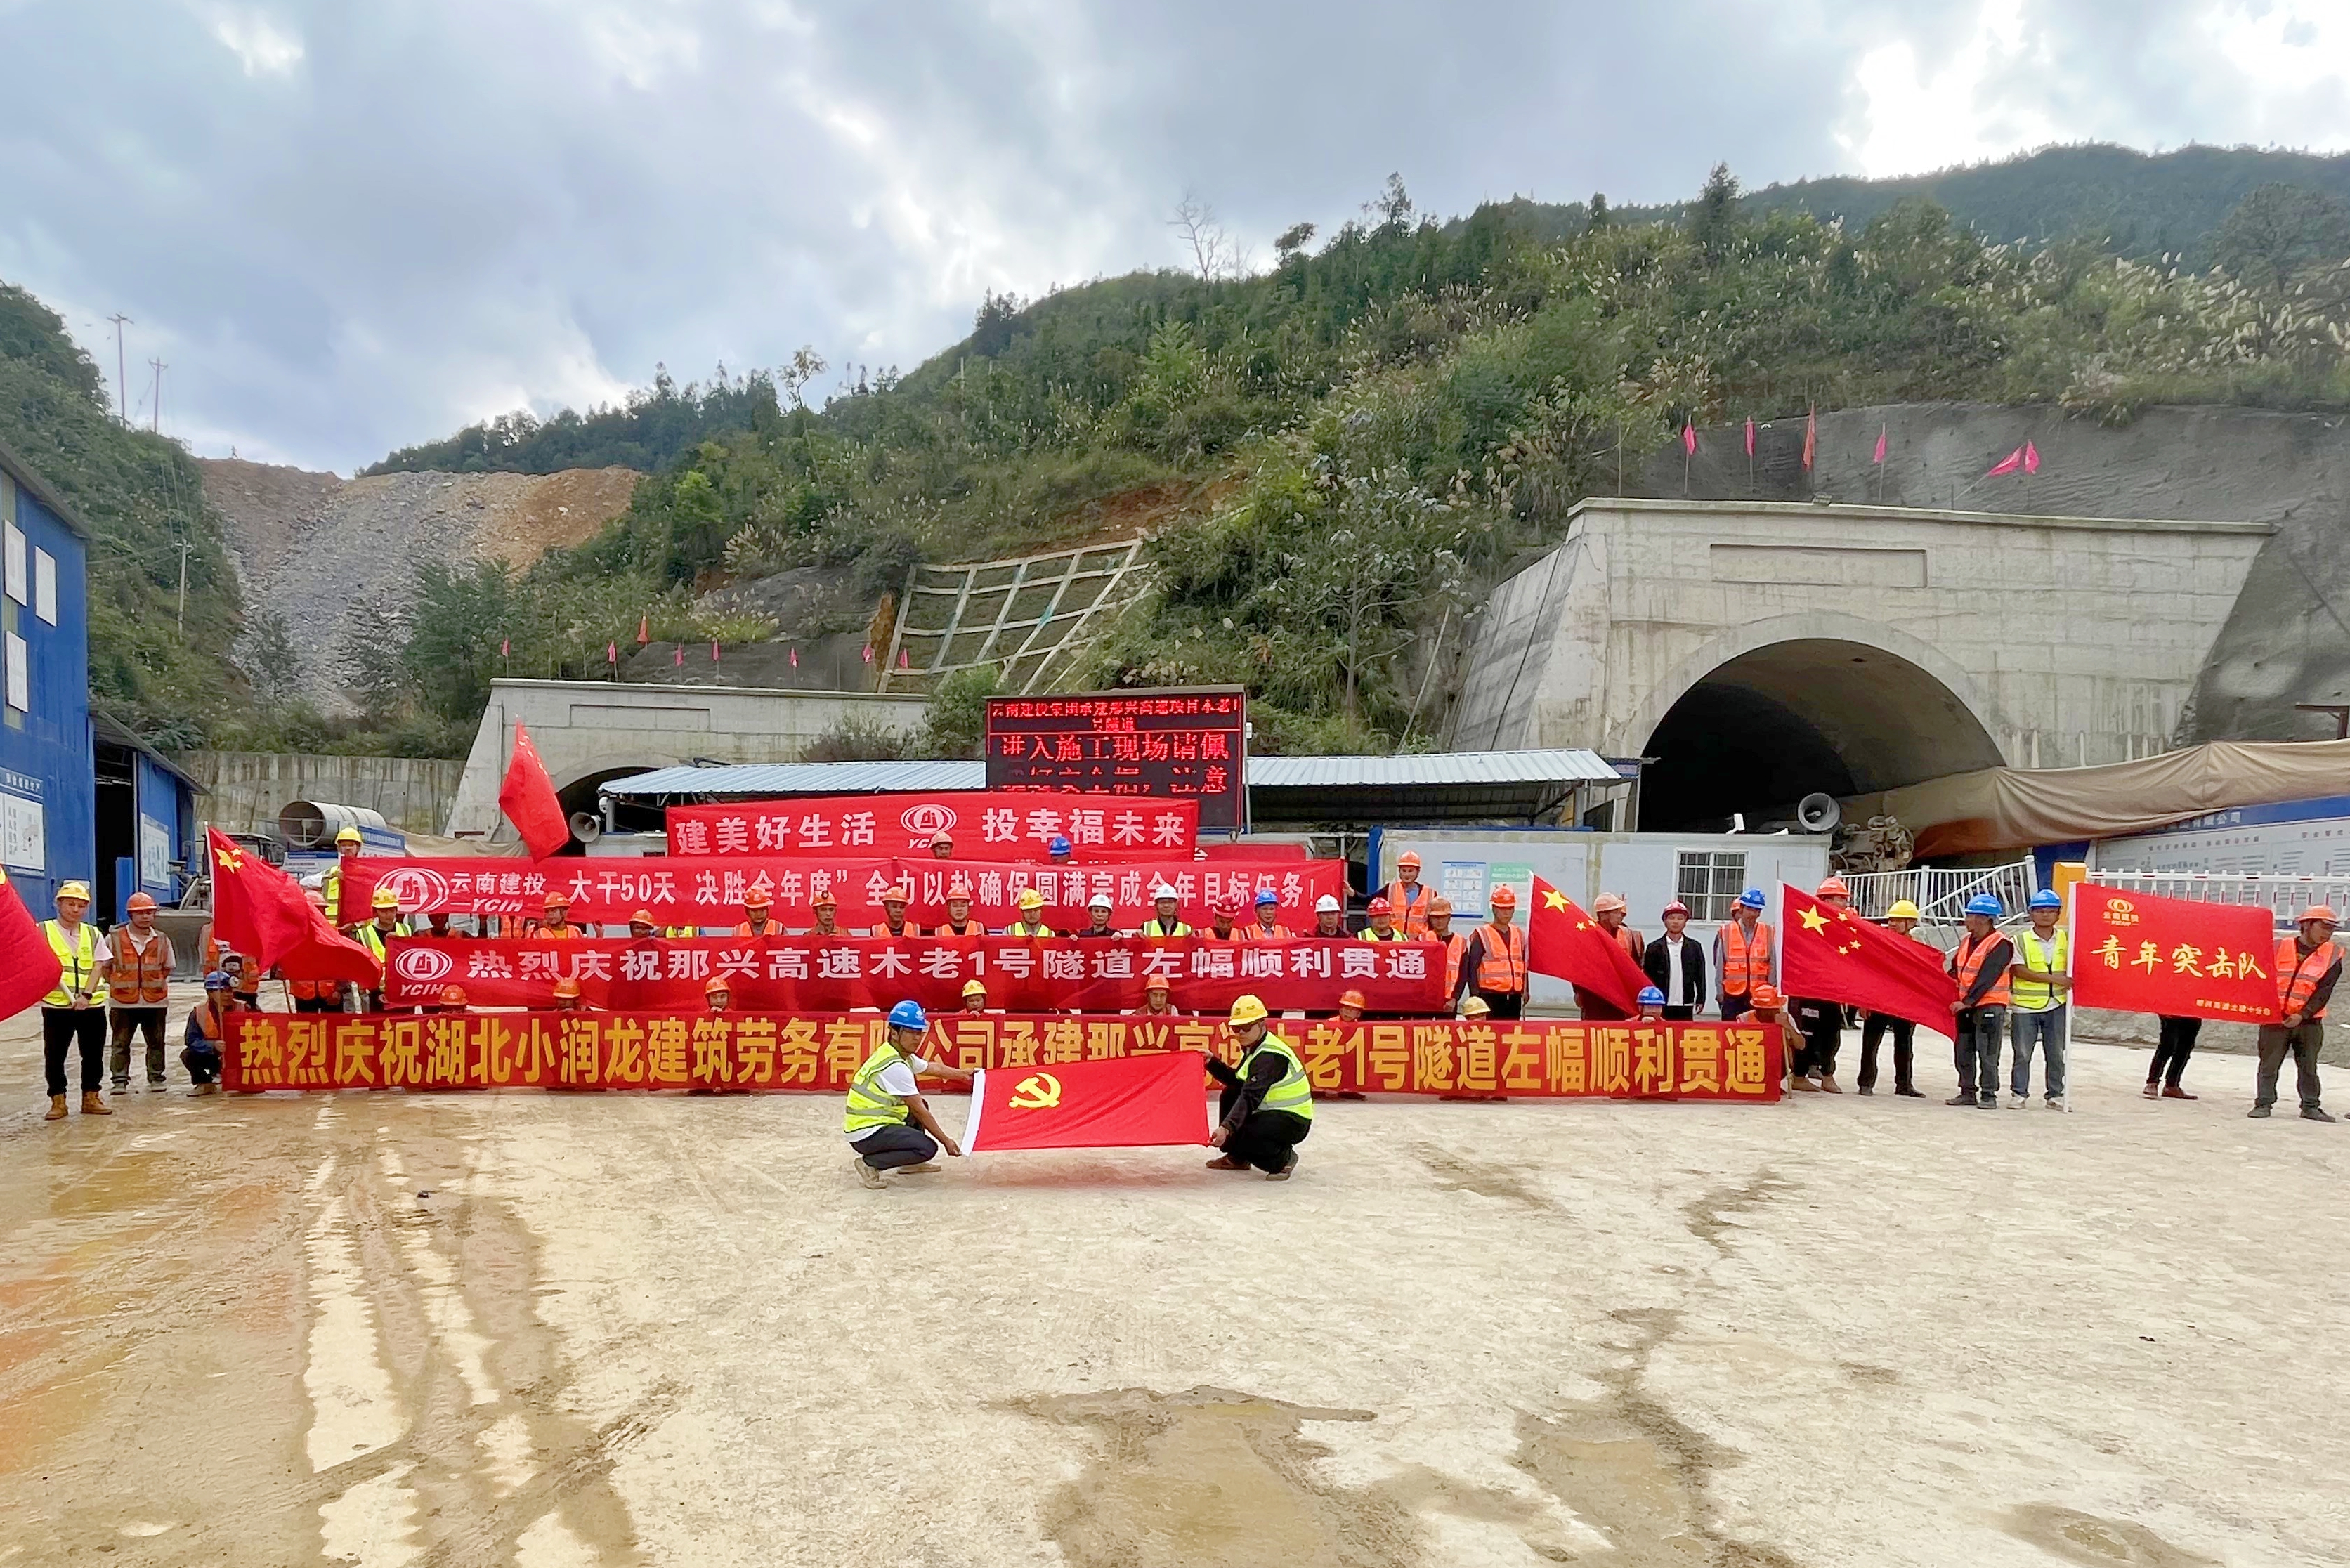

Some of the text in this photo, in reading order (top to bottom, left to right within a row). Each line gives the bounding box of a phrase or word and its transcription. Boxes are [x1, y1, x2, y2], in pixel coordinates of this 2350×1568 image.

[676, 807, 1184, 854] 建美好生活 投幸福未来
[450, 871, 547, 896] 云南建投
[568, 870, 675, 904] 大干50天
[471, 899, 523, 912] YCIH
[467, 946, 1427, 981] 热烈庆祝那兴高速木老1号隧道左幅顺利贯通
[2091, 934, 2267, 980] 青年突击队
[400, 984, 444, 996] YCIH
